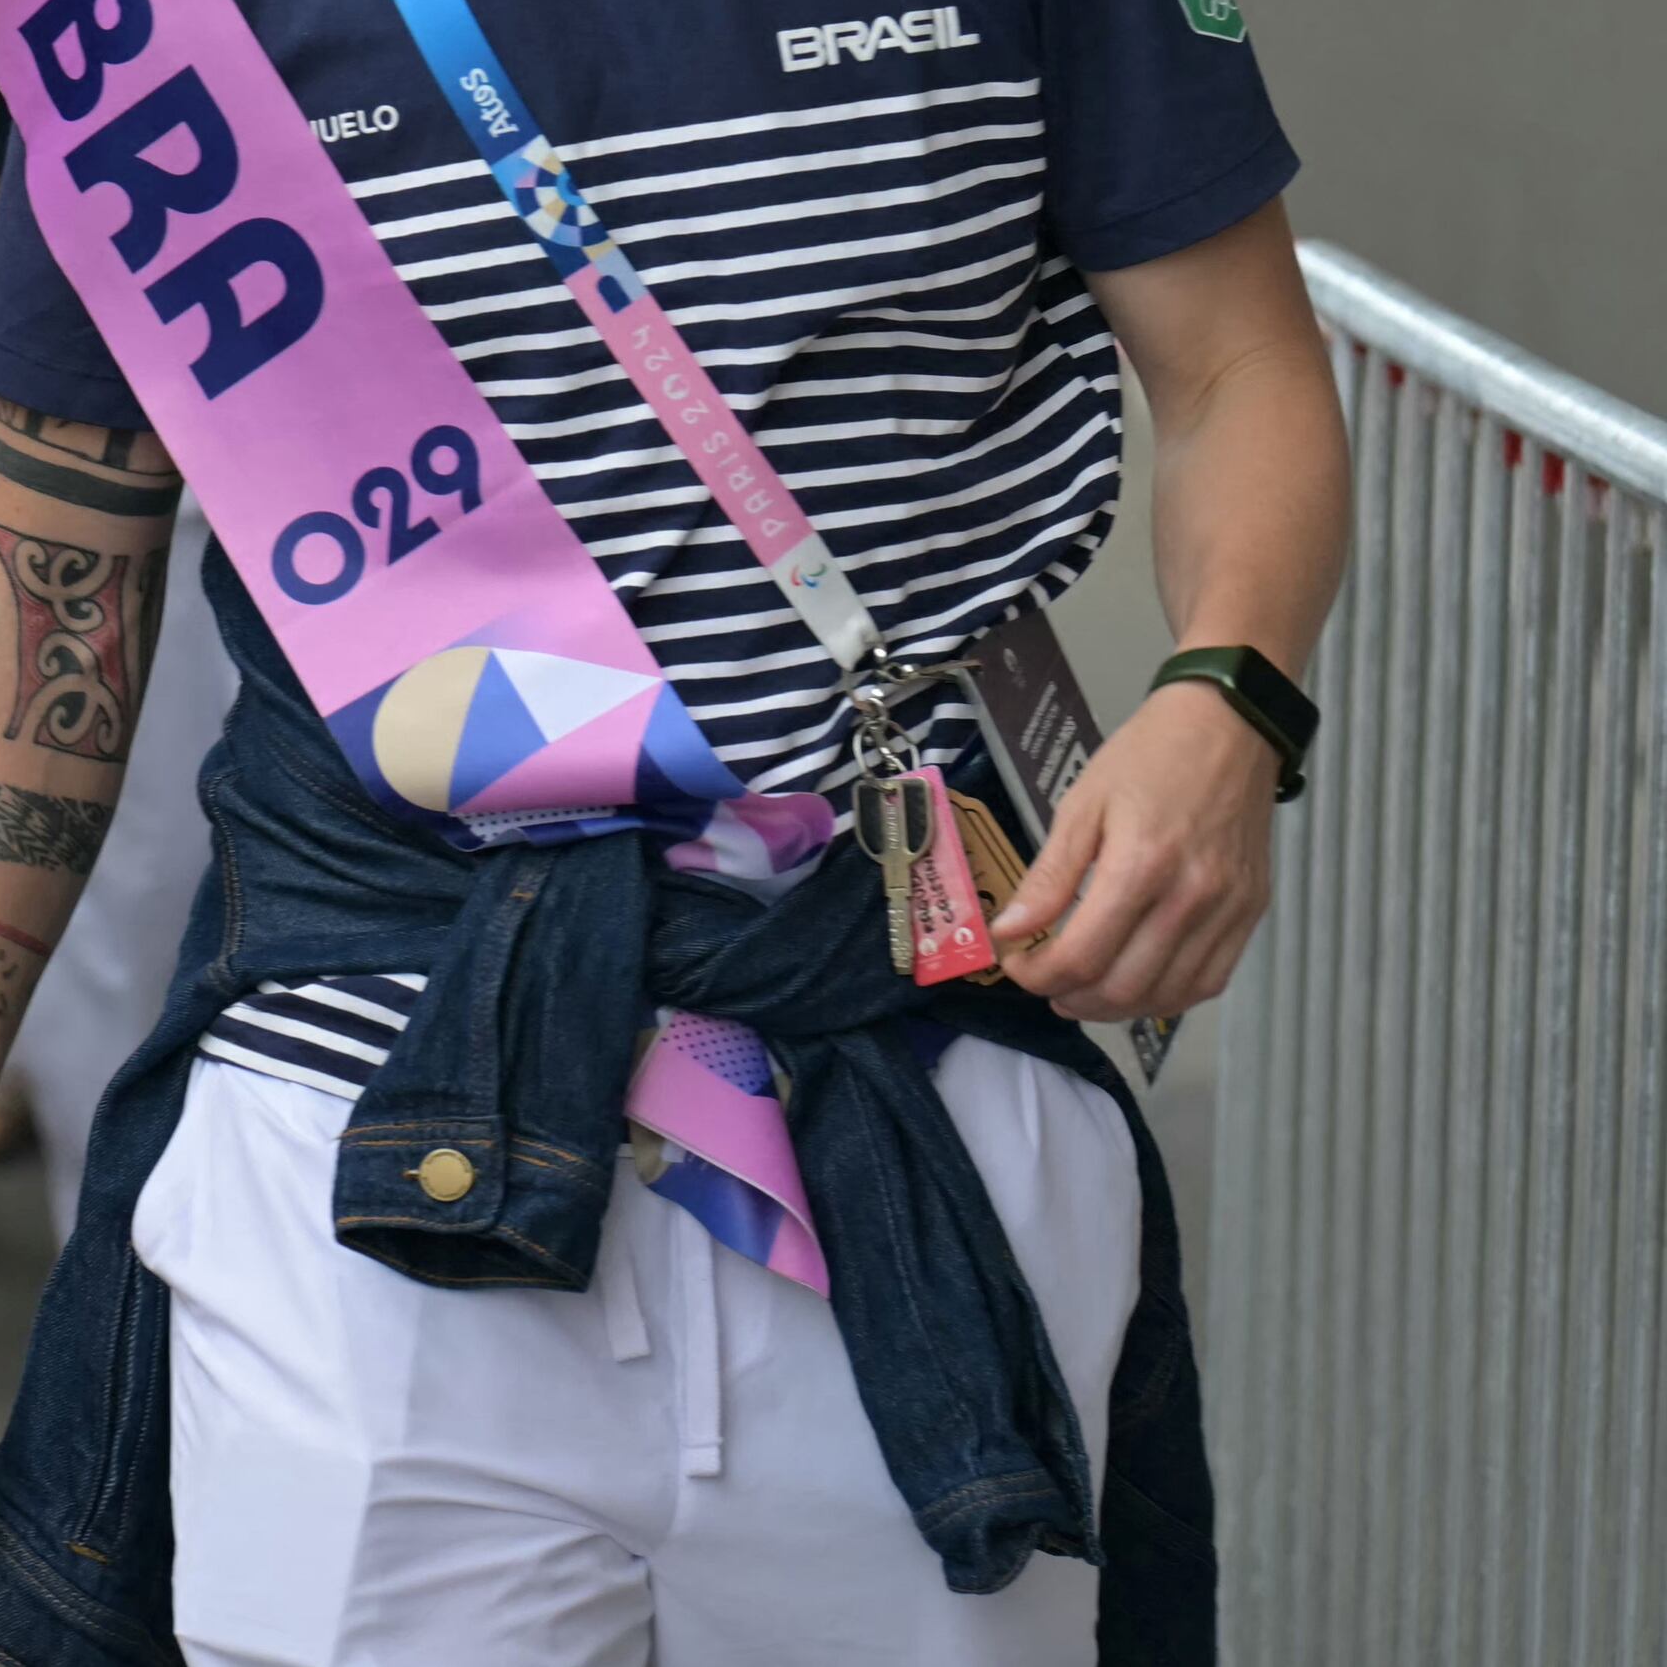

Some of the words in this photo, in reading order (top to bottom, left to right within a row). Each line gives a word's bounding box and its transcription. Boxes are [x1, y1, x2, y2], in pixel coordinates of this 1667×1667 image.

[776, 5, 981, 73] BRASIL
[460, 68, 520, 138] Atos
[633, 324, 711, 425] 2024
[701, 430, 790, 538] PARIS
